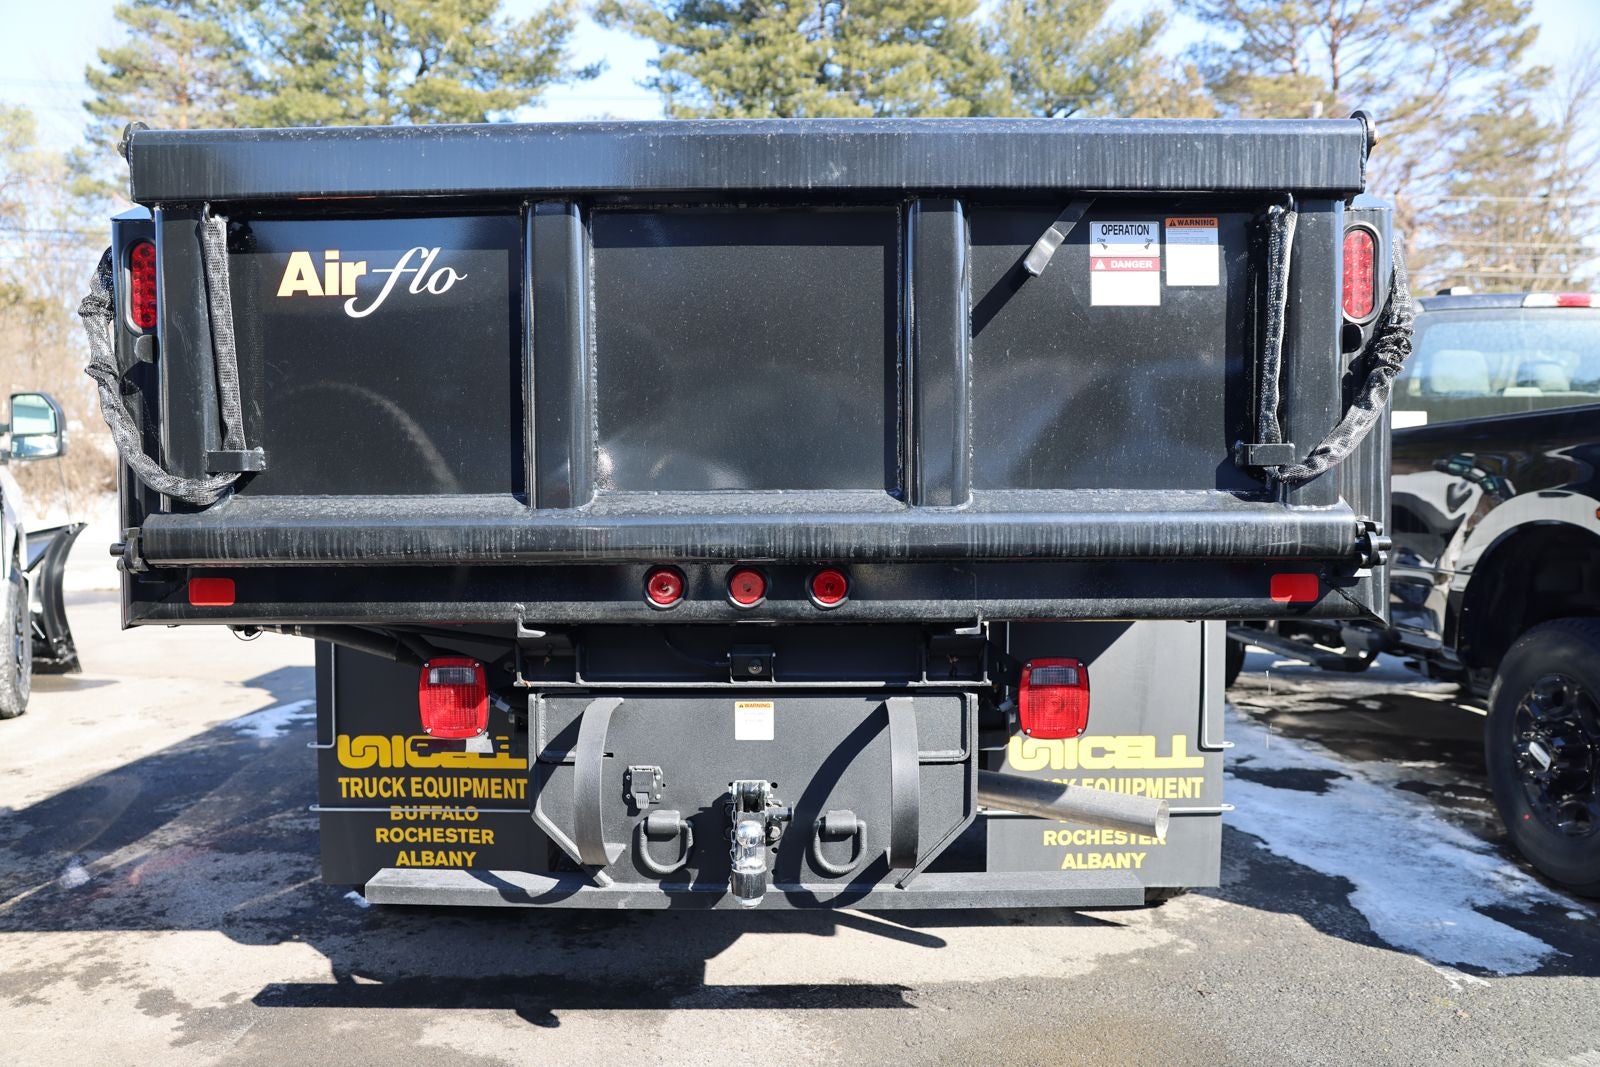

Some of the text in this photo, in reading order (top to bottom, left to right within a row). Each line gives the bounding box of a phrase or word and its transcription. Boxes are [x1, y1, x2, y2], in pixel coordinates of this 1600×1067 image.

[1101, 224, 1150, 236] OPERATION
[1110, 260, 1153, 269] DANGER
[276, 246, 468, 318] Air flo
[1007, 735, 1204, 771] UNICELL
[338, 776, 529, 799] TRUCK EQUIPMENT
[390, 805, 479, 821] BUFFALO
[375, 828, 495, 845] ROCHESTER
[1043, 829, 1167, 846] ROCHESTER
[396, 850, 477, 867] ALBANY
[1061, 852, 1147, 870] ALBANY
